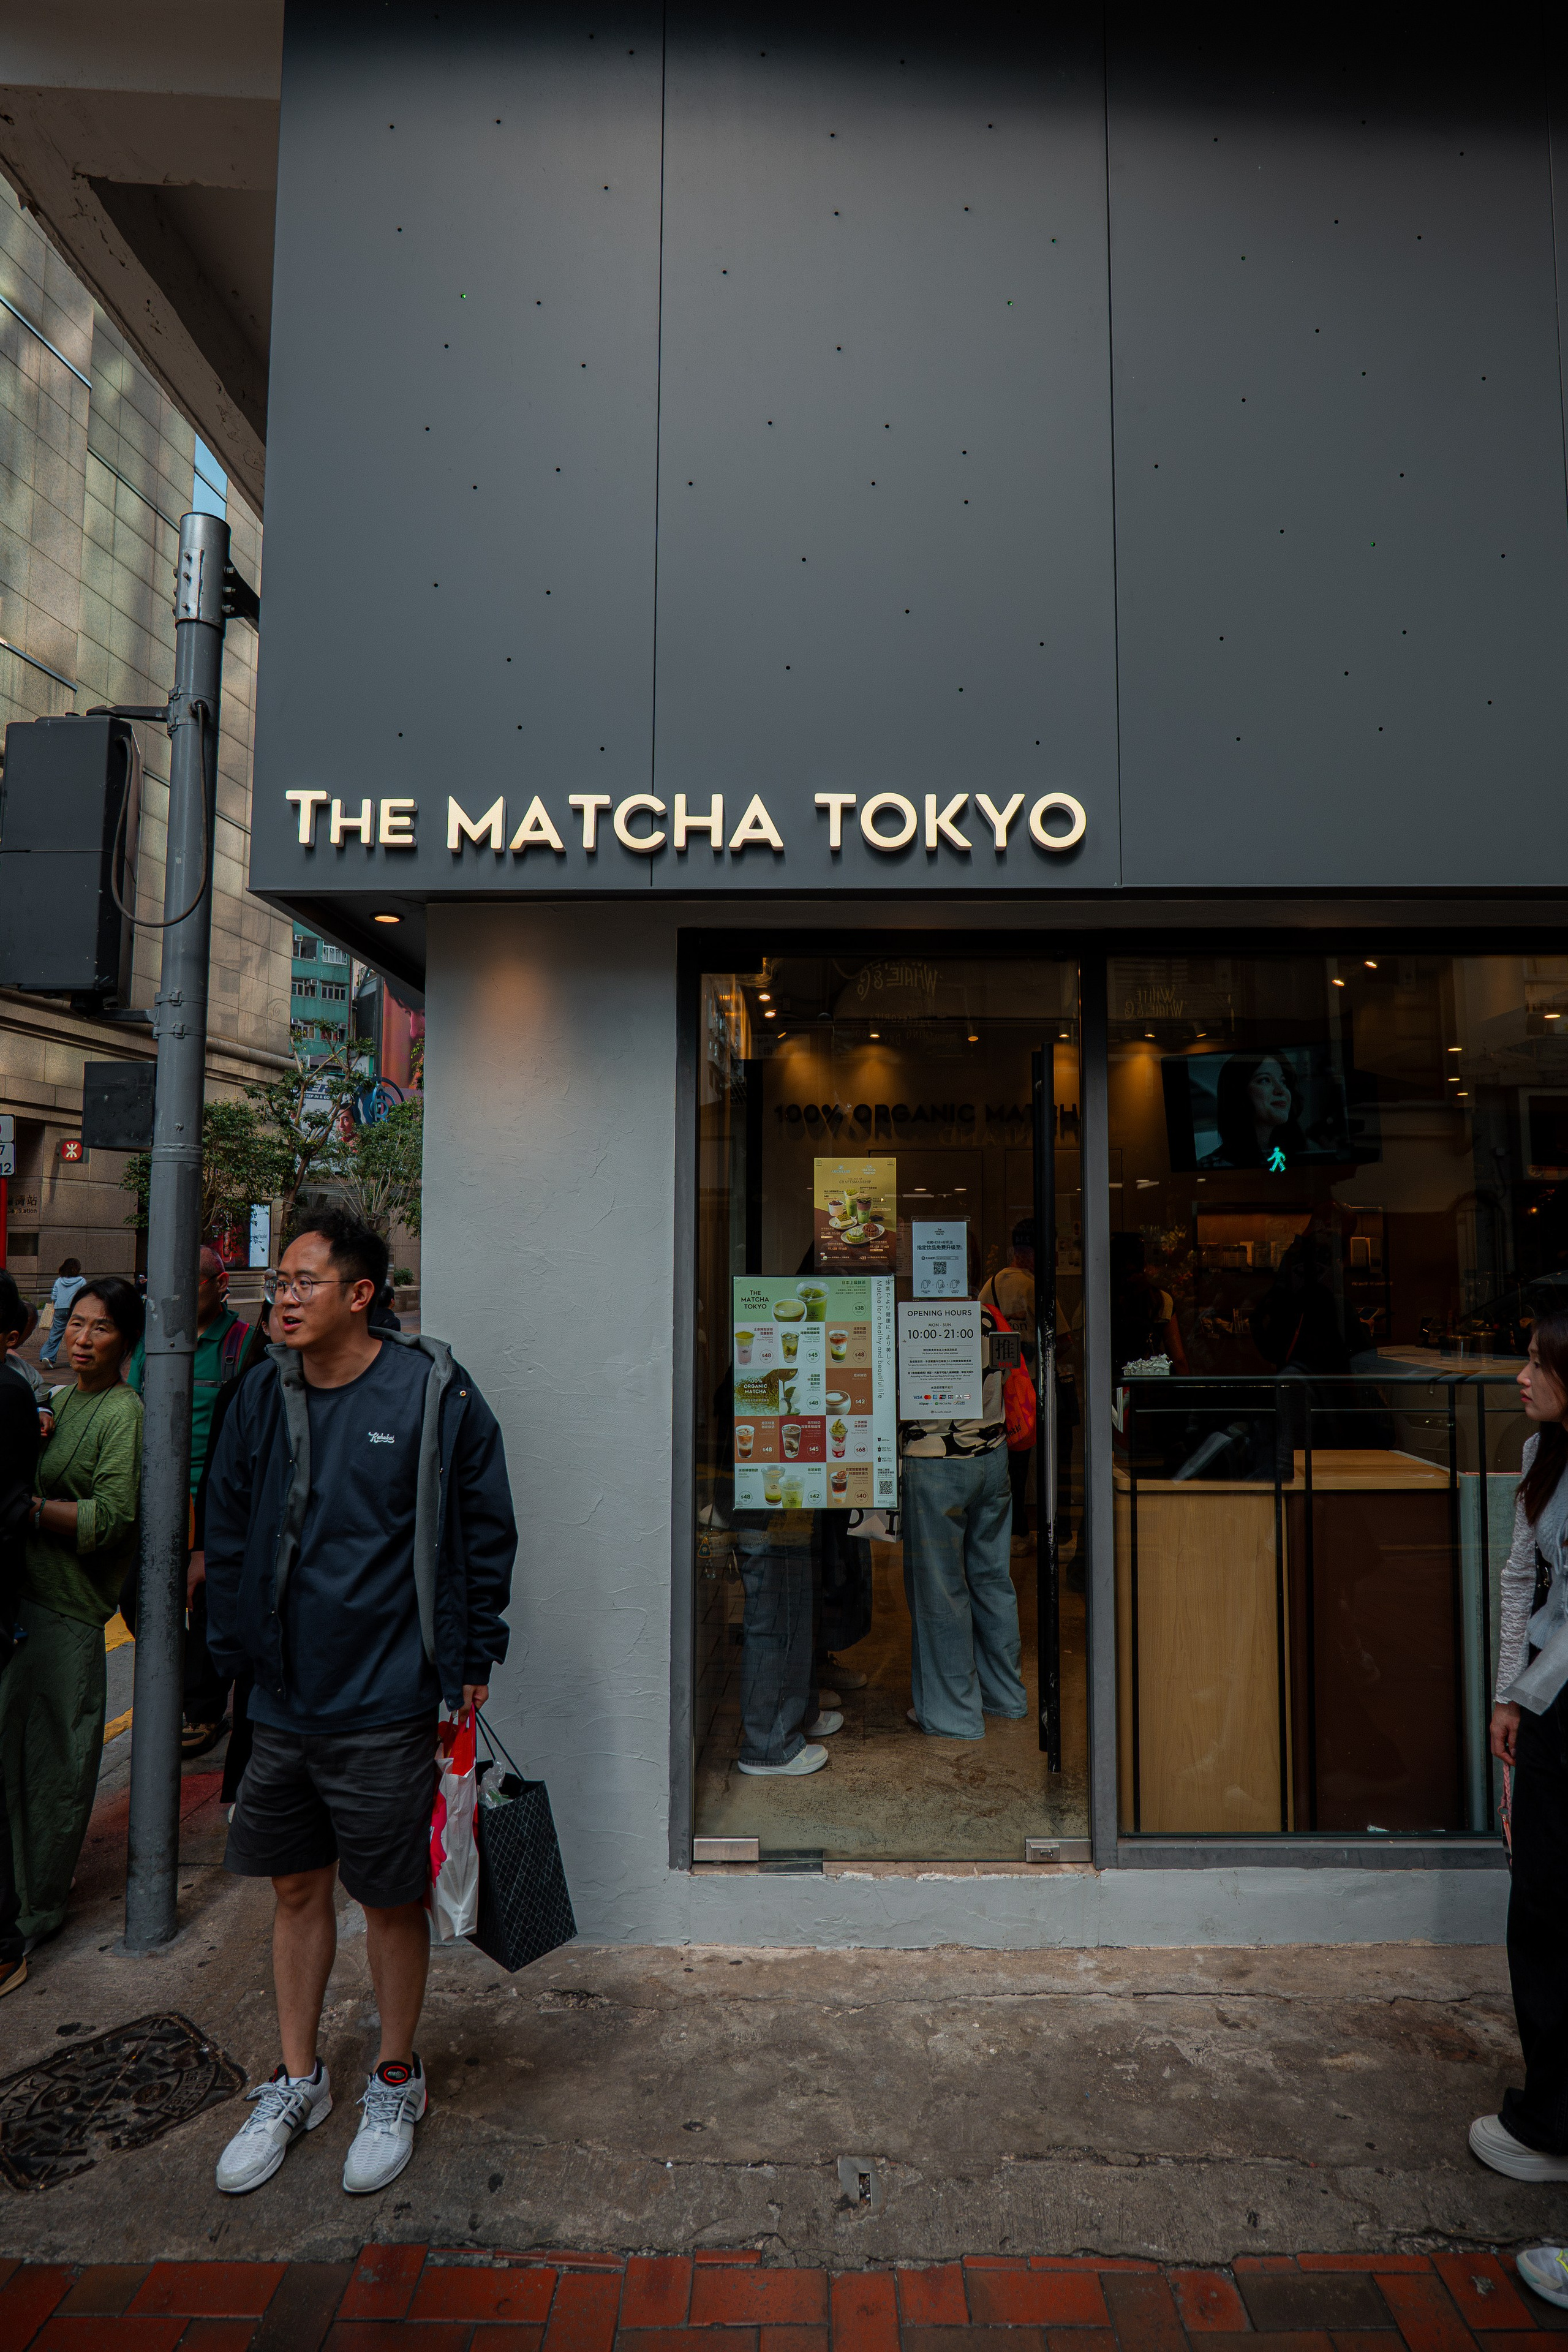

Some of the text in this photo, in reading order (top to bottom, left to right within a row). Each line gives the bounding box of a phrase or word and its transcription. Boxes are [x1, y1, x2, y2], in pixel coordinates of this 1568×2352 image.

[285, 790, 1088, 853] THE MATCHA TOKYO
[774, 1103, 843, 1124] 100%
[853, 1103, 976, 1124] ORGANIC
[908, 1329, 937, 1339] 10:00
[944, 1329, 974, 1338] 21:00
[995, 1339, 1015, 1360] 推
